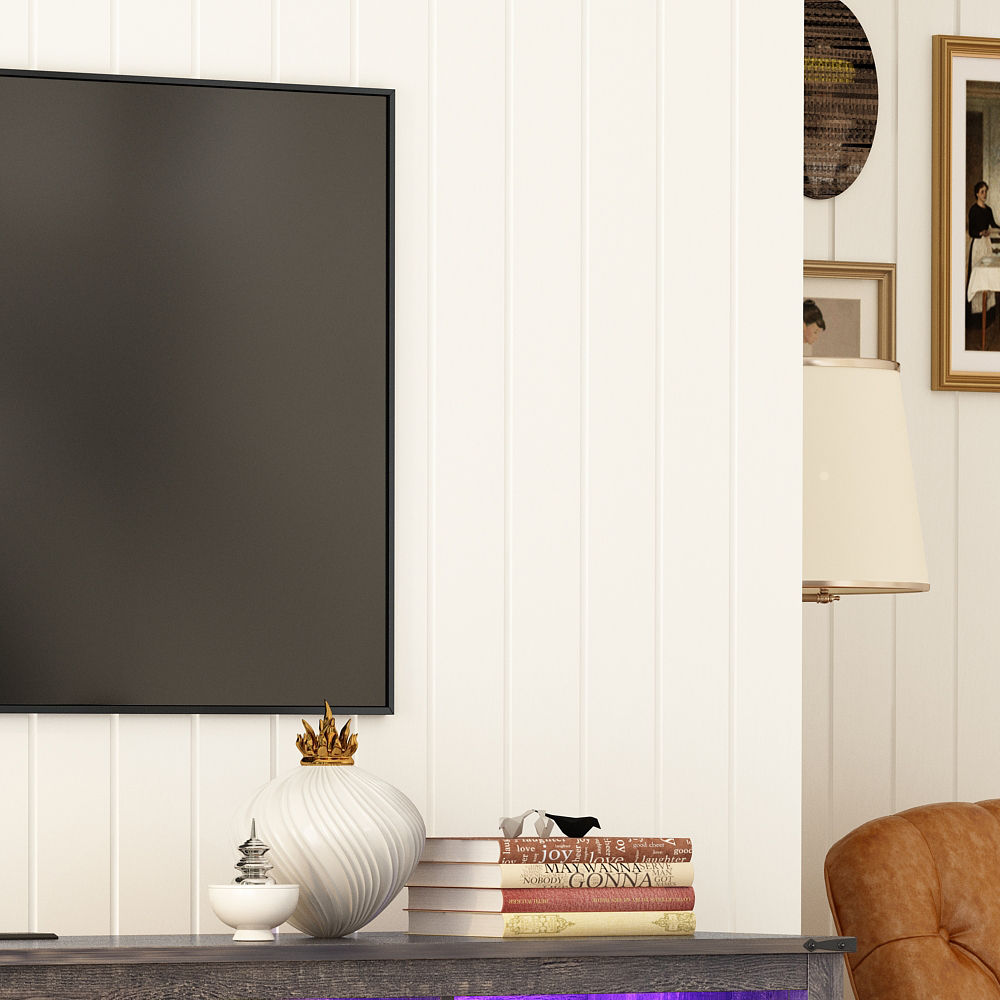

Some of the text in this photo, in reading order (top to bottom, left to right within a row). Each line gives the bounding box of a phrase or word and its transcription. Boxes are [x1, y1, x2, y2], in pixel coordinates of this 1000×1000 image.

[516, 844, 535, 853] love
[538, 844, 573, 864] joy
[589, 851, 624, 864] love
[545, 863, 580, 874] MAY
[582, 863, 641, 873] WANNA
[522, 876, 564, 885] NOBODY
[568, 872, 652, 889] GONNA
